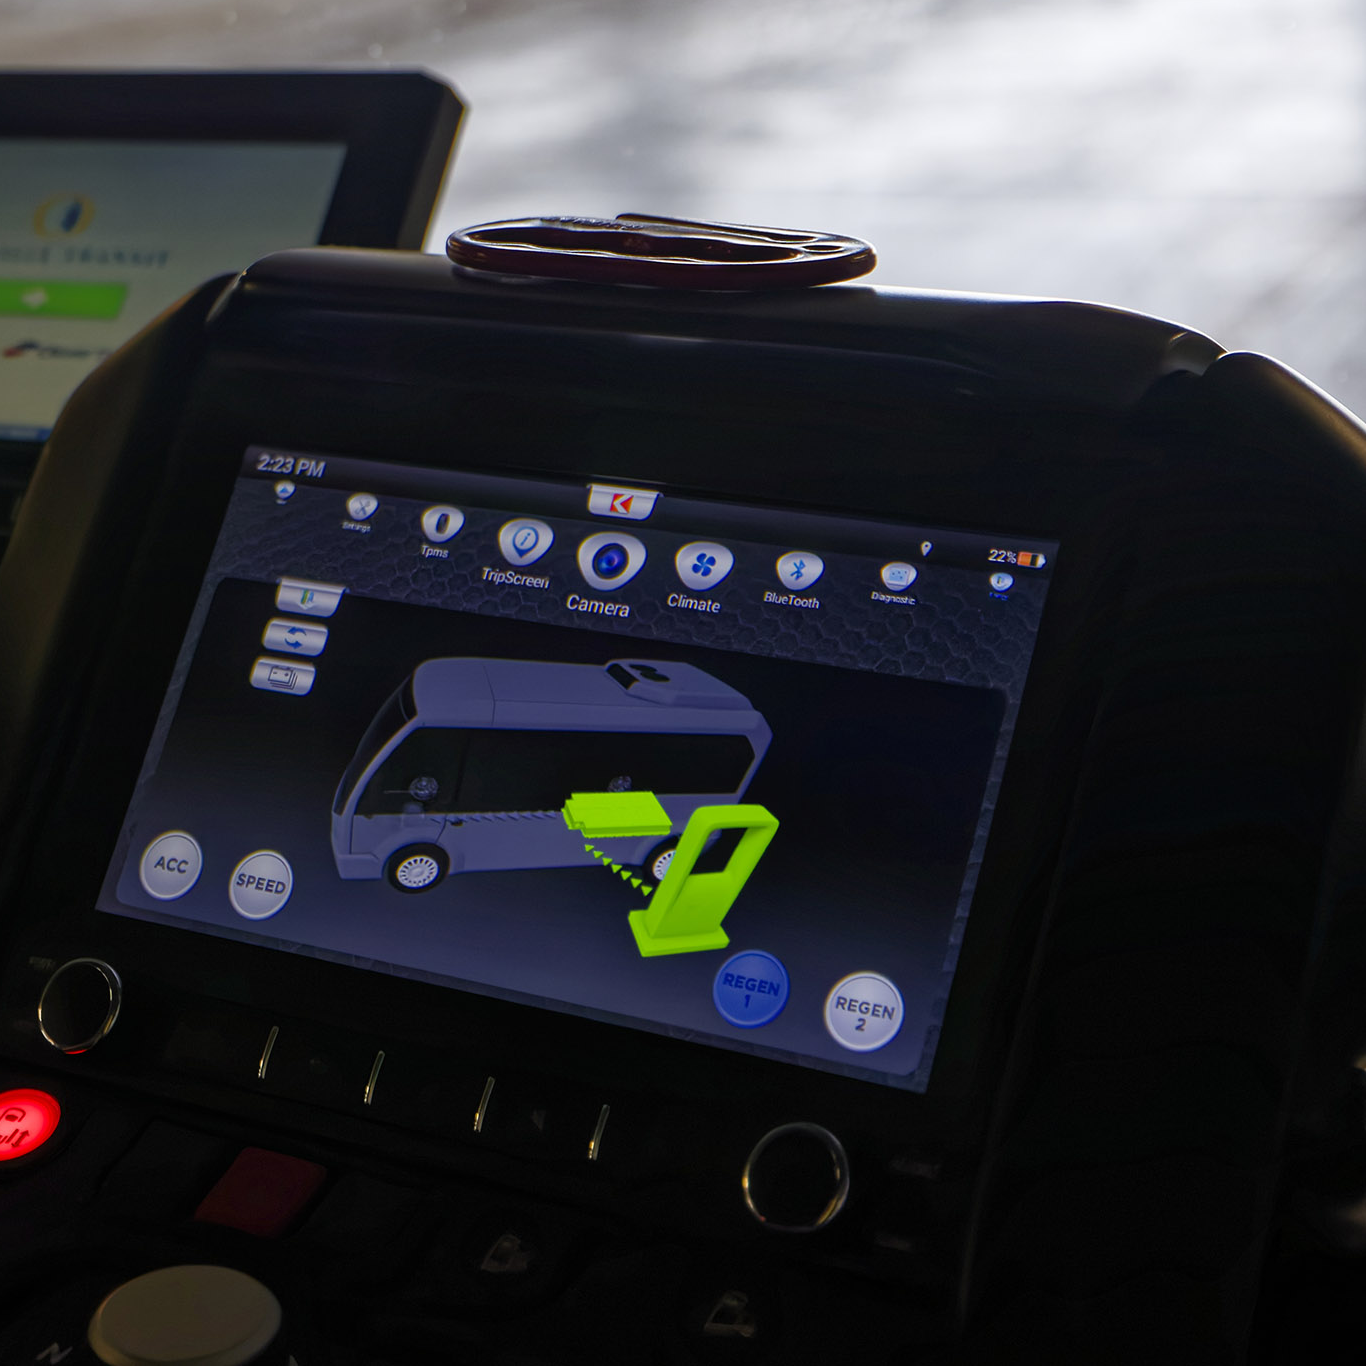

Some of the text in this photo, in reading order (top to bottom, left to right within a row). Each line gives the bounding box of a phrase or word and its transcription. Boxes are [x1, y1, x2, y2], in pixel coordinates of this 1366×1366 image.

[257, 454, 326, 478] 2:23 PM
[421, 545, 450, 558] Tpms
[988, 549, 1017, 564] 22%
[482, 567, 550, 589] TripScreen
[566, 594, 631, 618] Camera
[667, 593, 721, 614] Climate
[764, 591, 820, 609] BlueTooth
[154, 856, 188, 874] ACC
[236, 873, 286, 895] SPEED
[723, 972, 780, 997] REGEN
[744, 994, 751, 1008] 1
[835, 996, 895, 1020] REGEN
[855, 1017, 867, 1032] 2
